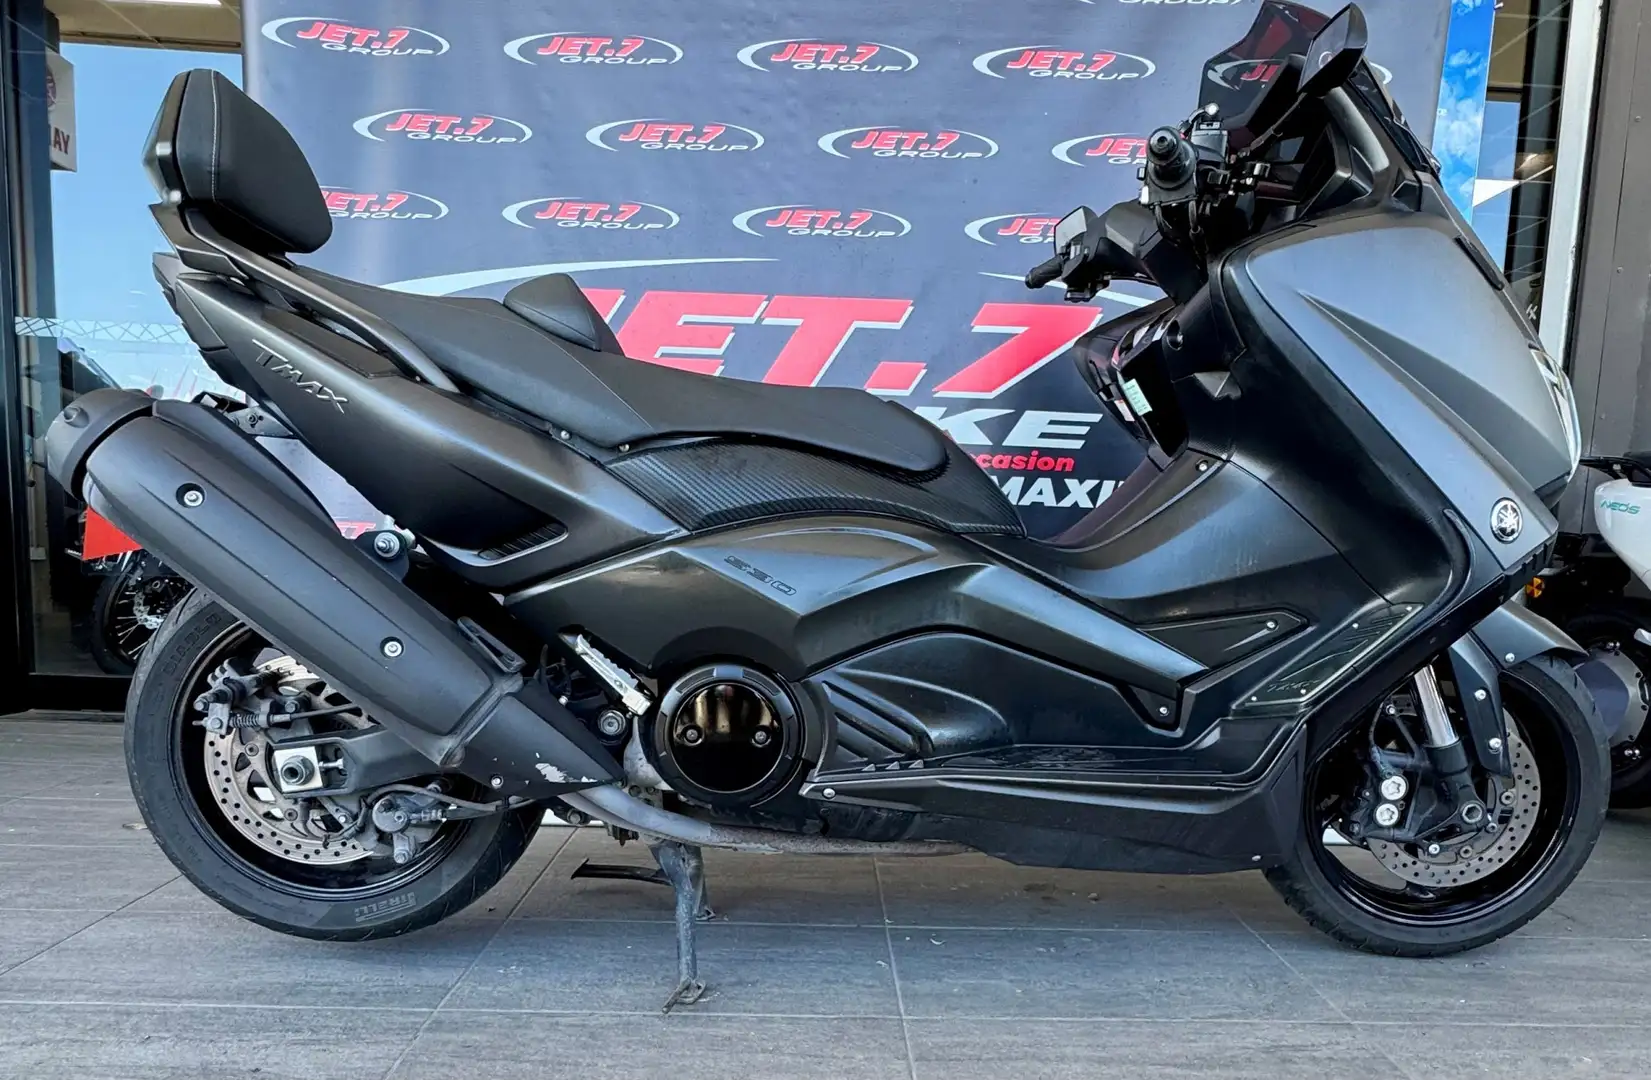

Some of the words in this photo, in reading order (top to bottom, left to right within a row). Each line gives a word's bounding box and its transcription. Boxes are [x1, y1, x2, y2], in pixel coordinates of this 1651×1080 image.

[297, 22, 409, 49] JET.7
[322, 42, 434, 56] GROUP
[537, 36, 645, 56] JET.7
[770, 43, 880, 64] JET.7
[559, 55, 668, 65] GROUP
[792, 62, 904, 72] GROUP
[1006, 50, 1117, 72] JET.7
[1029, 69, 1140, 80] GROUP
[385, 113, 493, 135] JET.7
[618, 123, 725, 143] JET.7
[407, 132, 518, 143] GROUP
[640, 141, 749, 151] GROUP
[851, 131, 960, 150] JET.7
[873, 149, 983, 159] GROUP
[321, 191, 409, 212] ET.7
[535, 202, 641, 222] JET.7
[765, 210, 873, 230] JET.7
[557, 220, 664, 230] GROUP
[787, 228, 896, 237] GROUP
[584, 288, 1103, 398] ET.7
[252, 338, 348, 414] TMAX
[354, 892, 417, 922] PIRELLI
